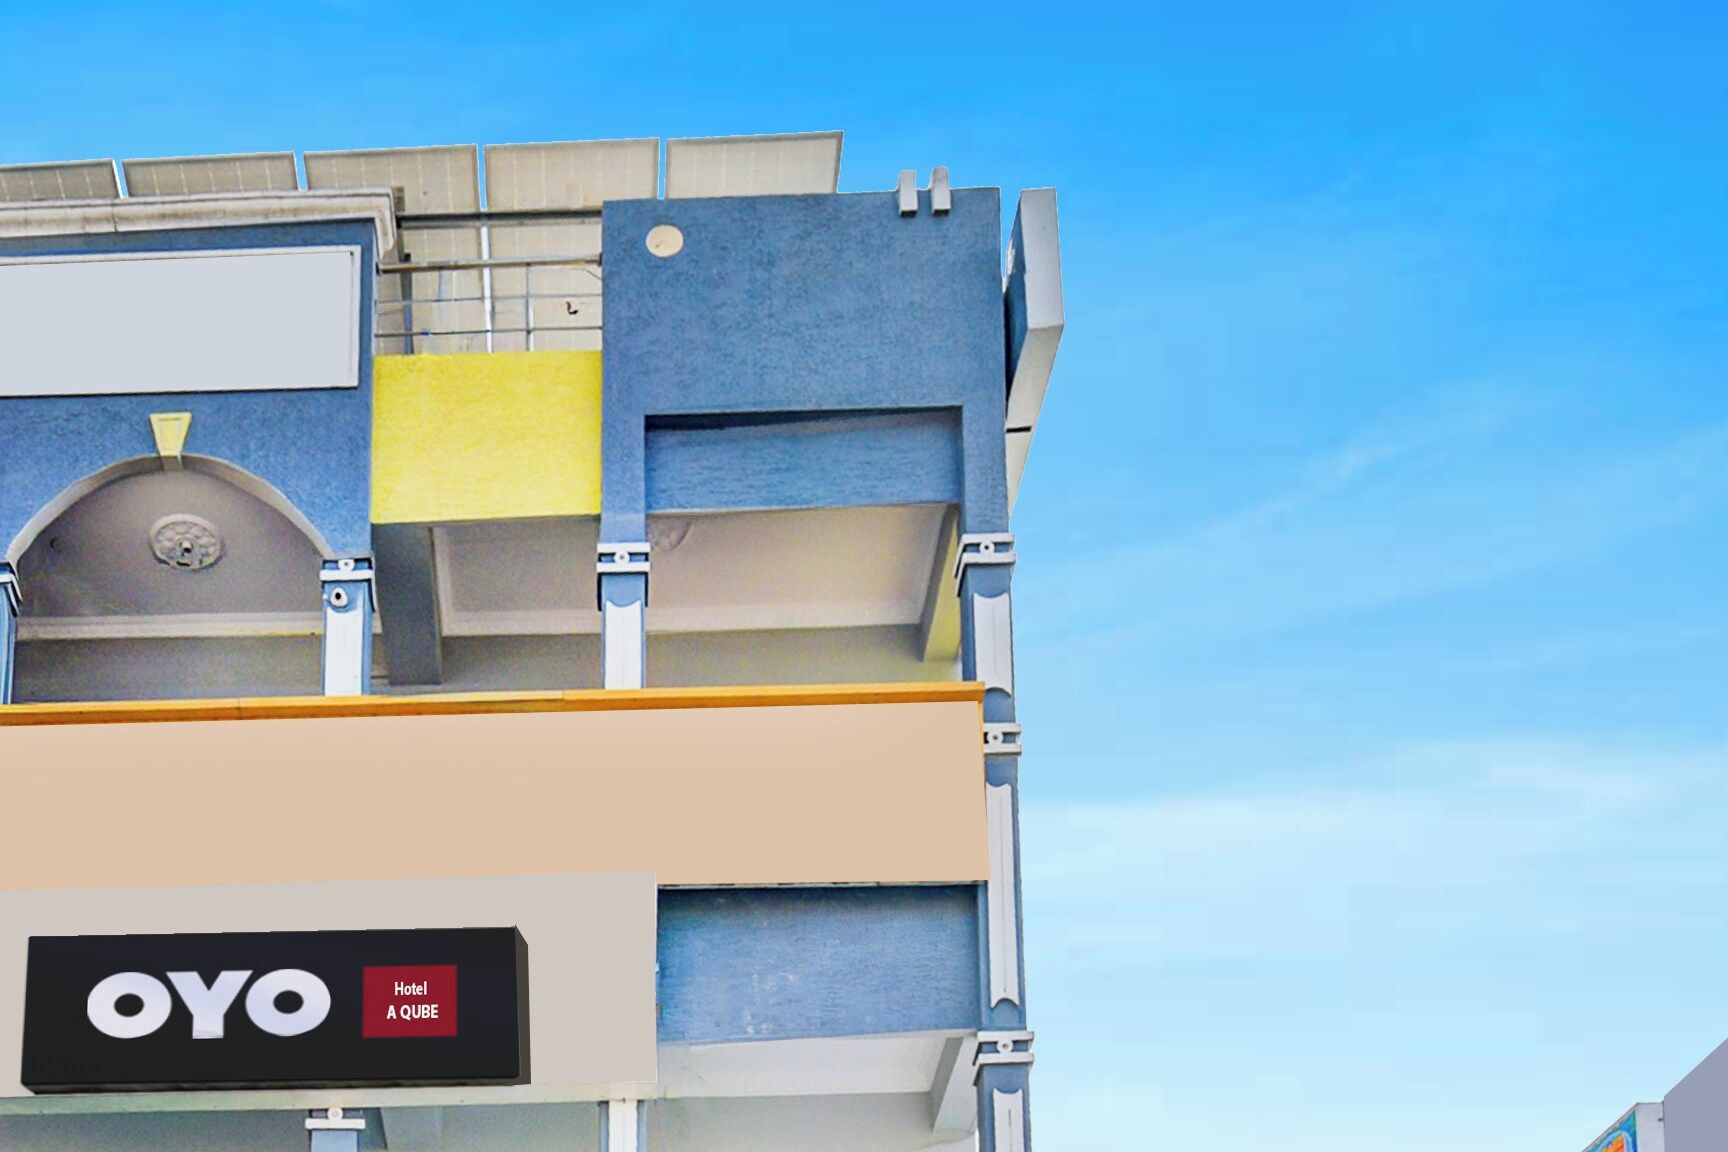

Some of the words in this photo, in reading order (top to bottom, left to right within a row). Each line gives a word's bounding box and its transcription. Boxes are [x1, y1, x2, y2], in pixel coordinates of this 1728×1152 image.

[394, 981, 428, 996] Hotel
[87, 969, 331, 1039] OYO
[386, 1004, 397, 1020] A
[400, 1004, 439, 1021] QUBE
